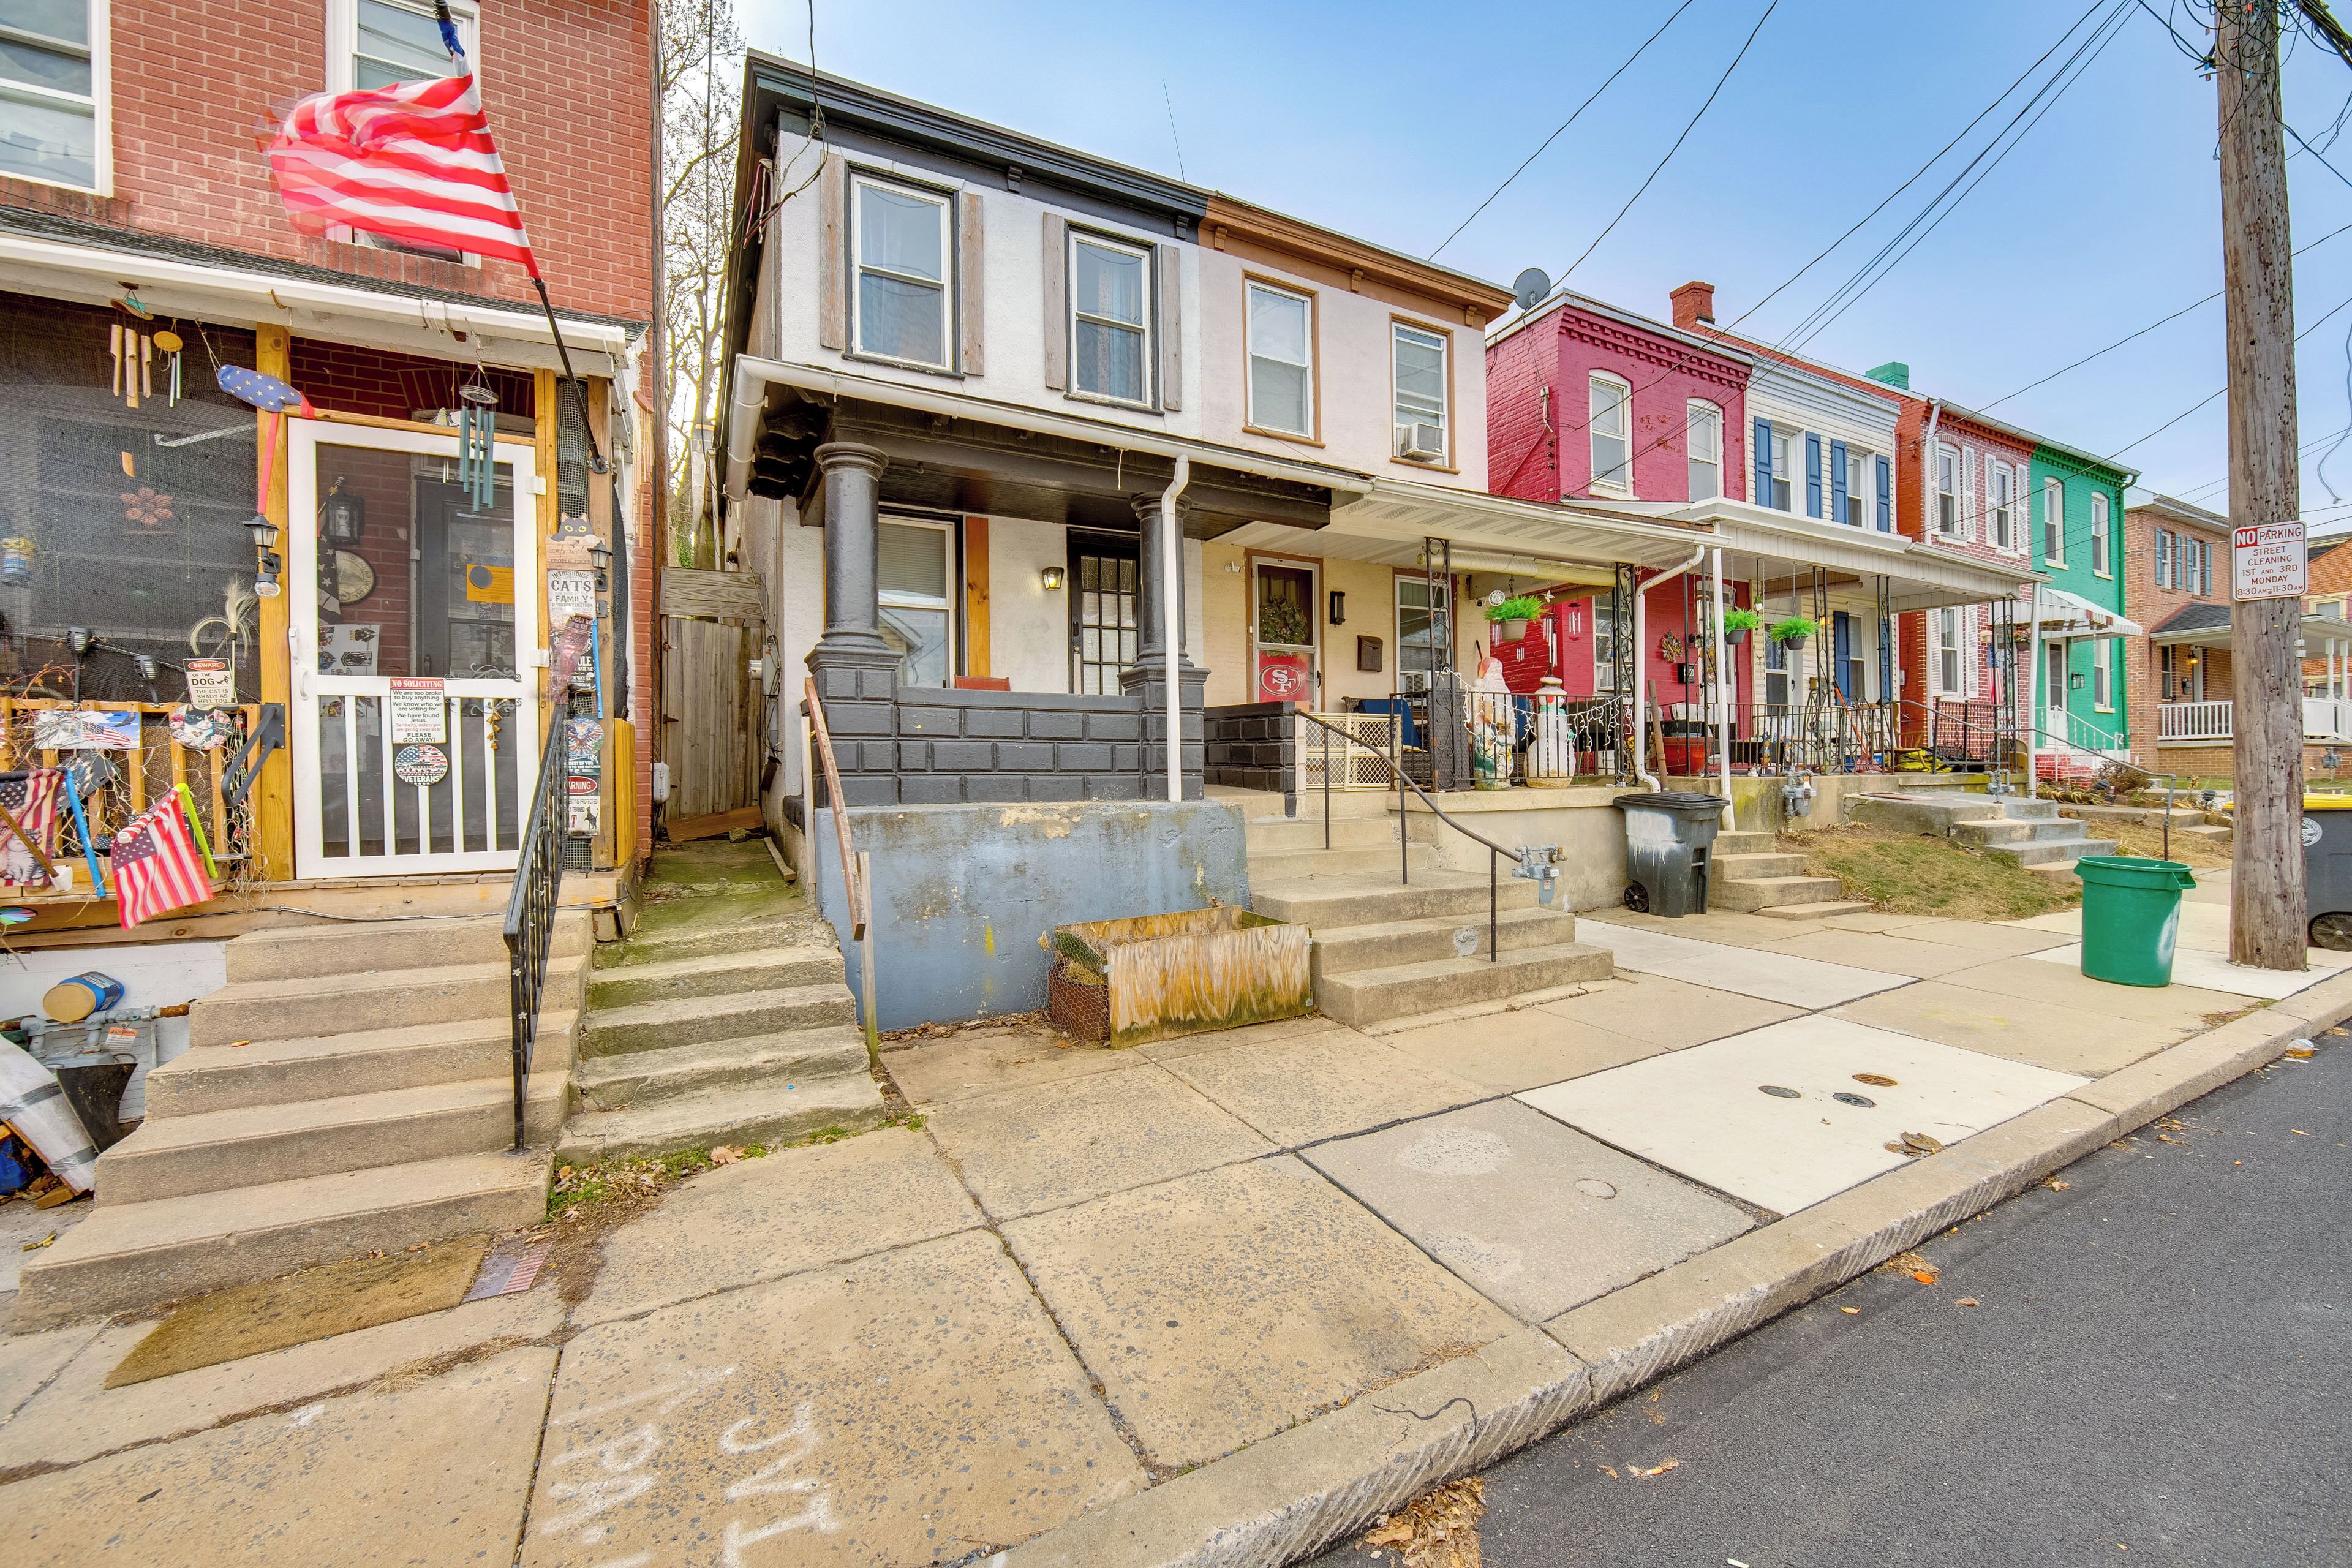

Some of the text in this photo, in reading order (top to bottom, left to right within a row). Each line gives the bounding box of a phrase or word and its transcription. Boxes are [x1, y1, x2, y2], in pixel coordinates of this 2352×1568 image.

[2236, 527, 2301, 546] NO PARKING
[2253, 546, 2286, 556] STREET
[2248, 555, 2293, 566] CLEANING
[2279, 564, 2298, 573] 3RD
[572, 570, 589, 579] HOUSE
[2252, 575, 2288, 585] MONDAY
[551, 579, 592, 592] CATS
[2237, 587, 2257, 596] 8:30
[1272, 669, 1296, 692] SF
[568, 781, 591, 790] ARNING
